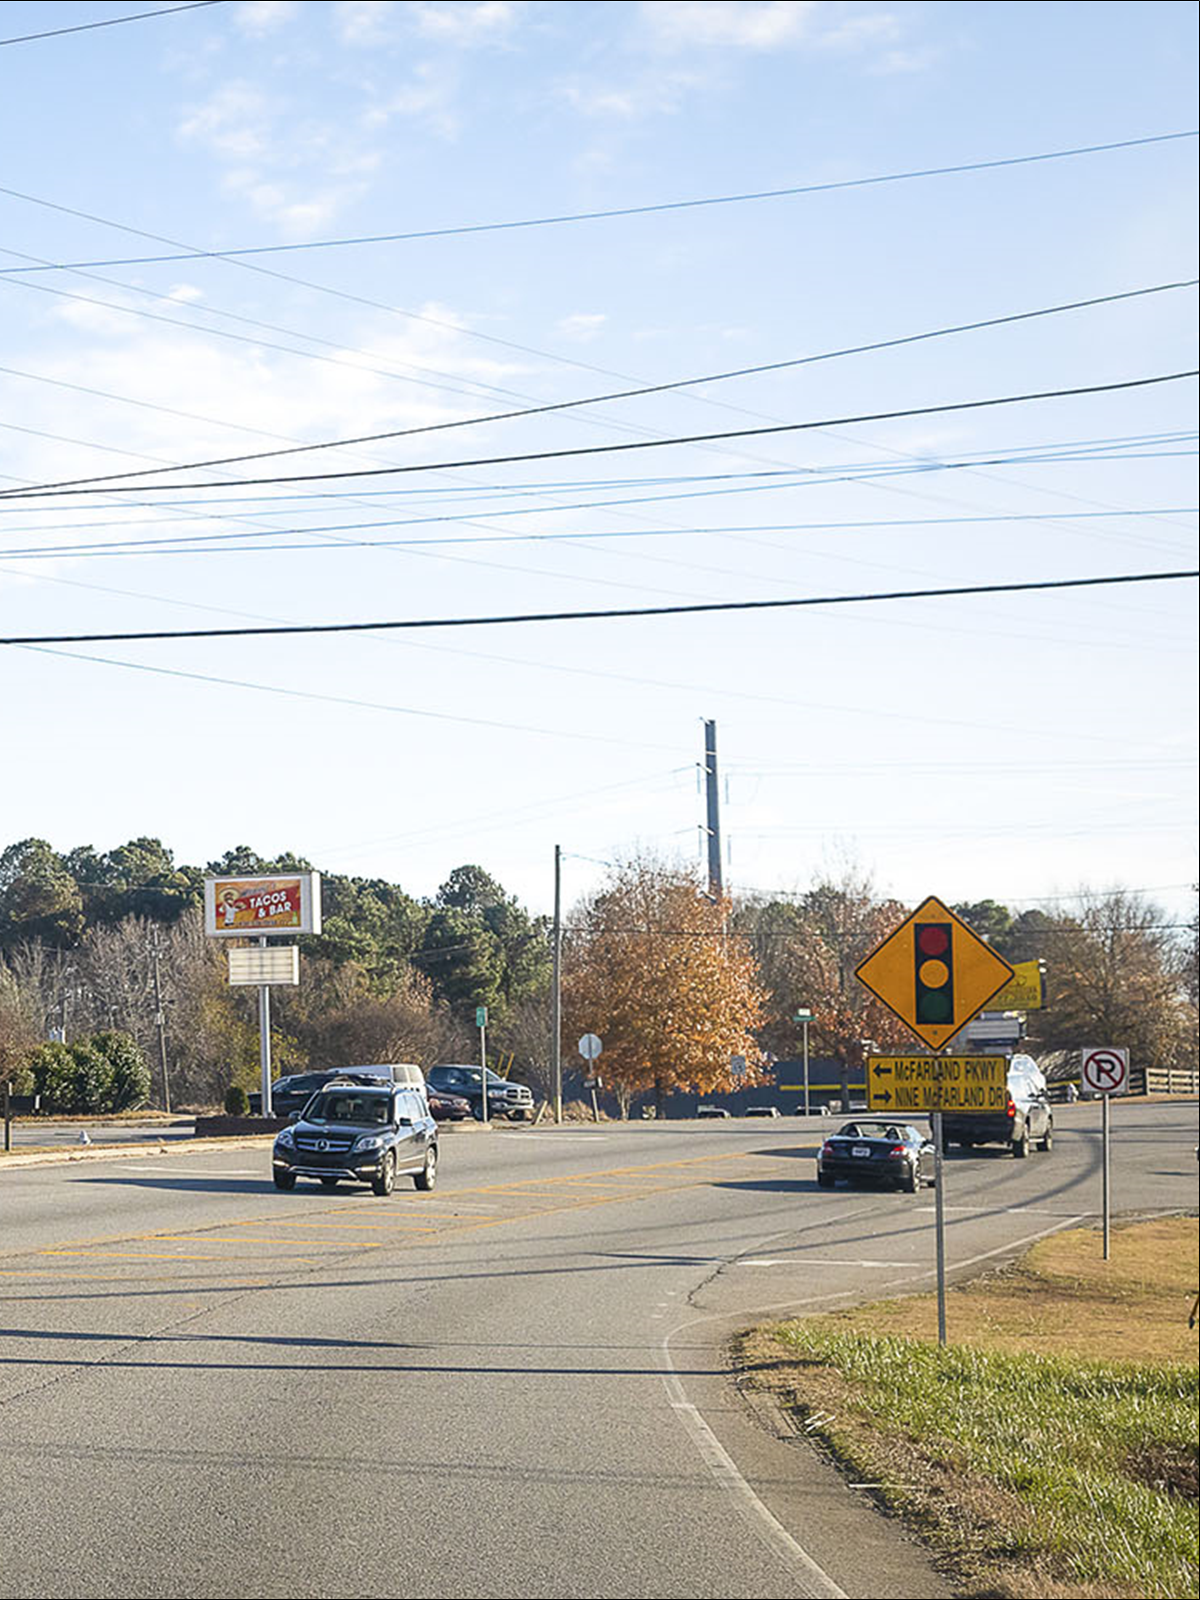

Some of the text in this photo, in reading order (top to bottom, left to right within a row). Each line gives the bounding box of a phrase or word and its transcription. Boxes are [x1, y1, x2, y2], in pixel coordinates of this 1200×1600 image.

[249, 891, 286, 908] TACOS
[269, 901, 292, 916] BAR
[895, 1061, 997, 1081] McFARLAND PKWY
[895, 1087, 919, 1107] NINE
[923, 1087, 984, 1107] McFARLAND
